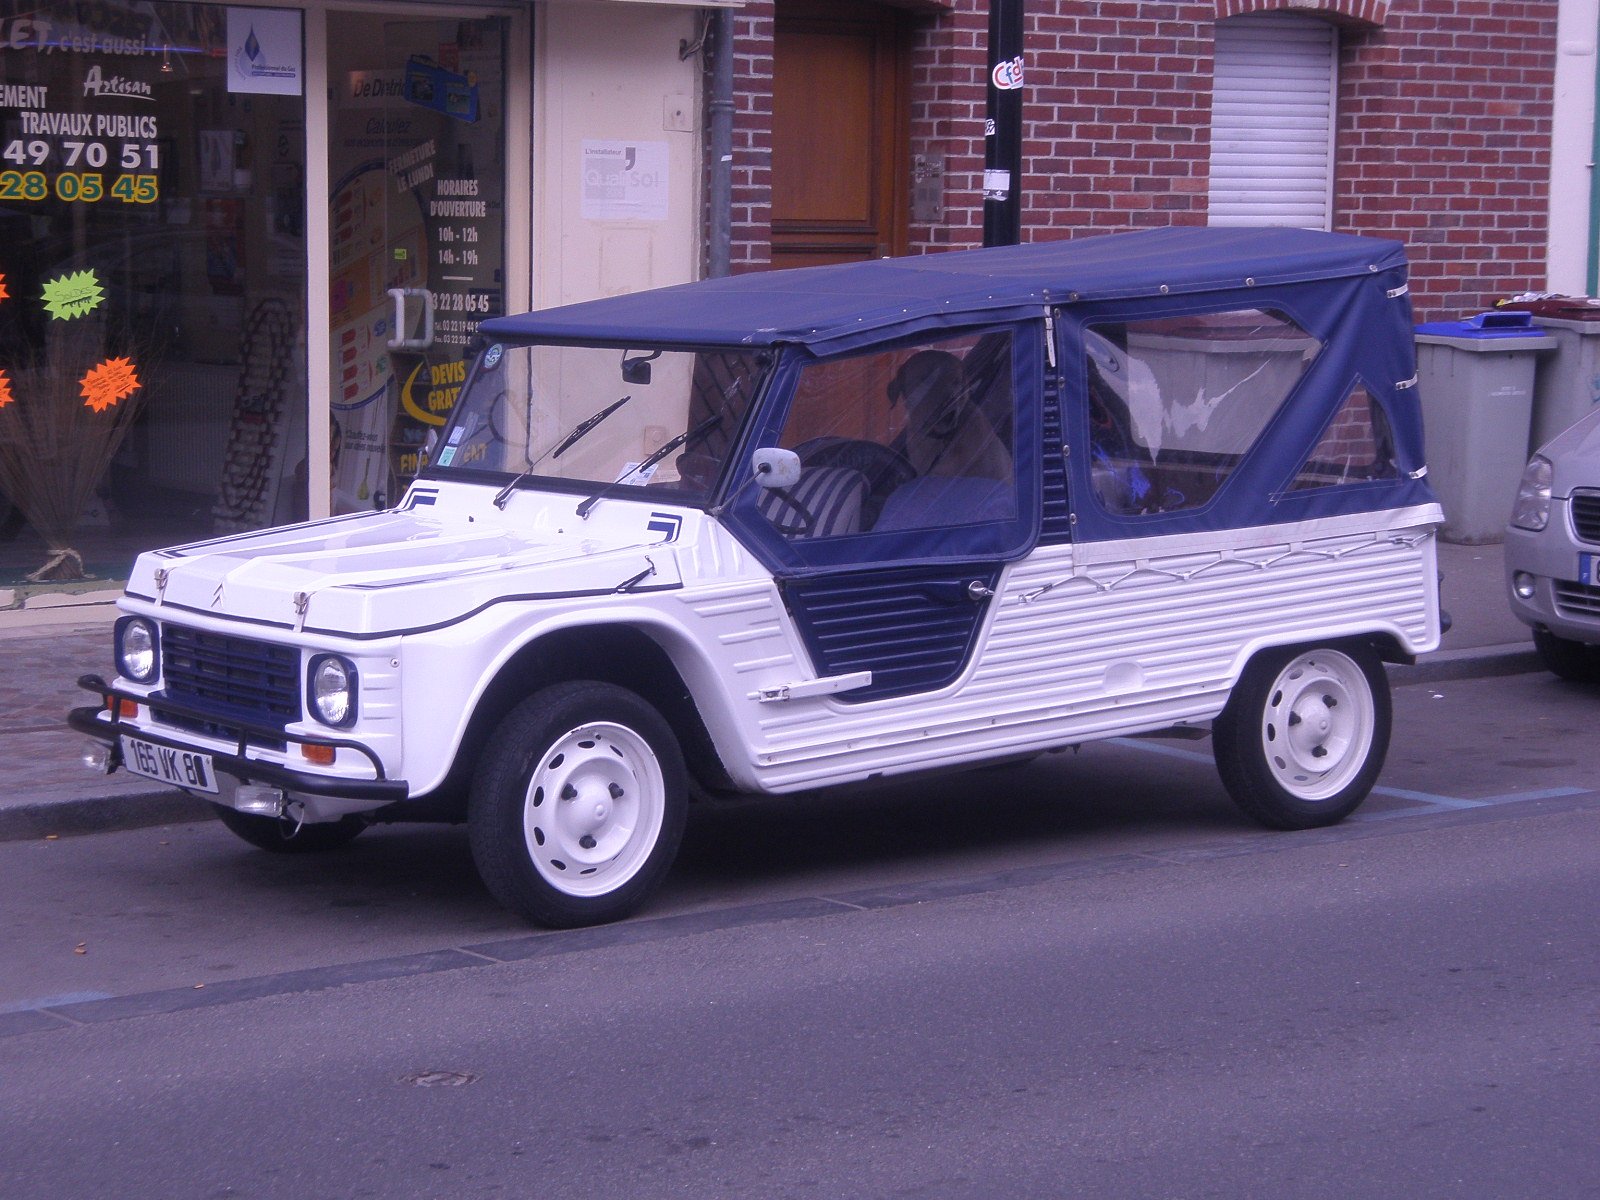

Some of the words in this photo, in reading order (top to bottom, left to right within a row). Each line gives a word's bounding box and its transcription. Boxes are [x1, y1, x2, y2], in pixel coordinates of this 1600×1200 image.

[102, 34, 145, 56] aussi
[84, 65, 152, 97] Artisan
[21, 111, 93, 136] TRAVAUX
[97, 114, 158, 139] PUBLICS
[3, 139, 49, 166] 49
[63, 141, 107, 168] 70
[121, 144, 159, 169] 51
[388, 139, 436, 176] FERMETURE
[0, 170, 48, 201] 28
[55, 172, 103, 203] 05
[111, 174, 159, 204] 45
[397, 176, 408, 194] LE
[408, 162, 434, 188] LUNDI
[437, 179, 478, 196] HORAIRES
[430, 201, 486, 217] D'OUVERTURE
[438, 226, 454, 242] 10h
[462, 226, 478, 242] 12h
[438, 249, 454, 265] 14h
[462, 249, 478, 265] 19h
[440, 293, 450, 310] 22
[452, 293, 463, 311] 28
[465, 294, 476, 312] 05
[477, 294, 489, 312] 45
[431, 360, 465, 385] DEVIS
[427, 386, 461, 411] GRAT
[131, 739, 159, 776] 165
[158, 747, 183, 783] VK
